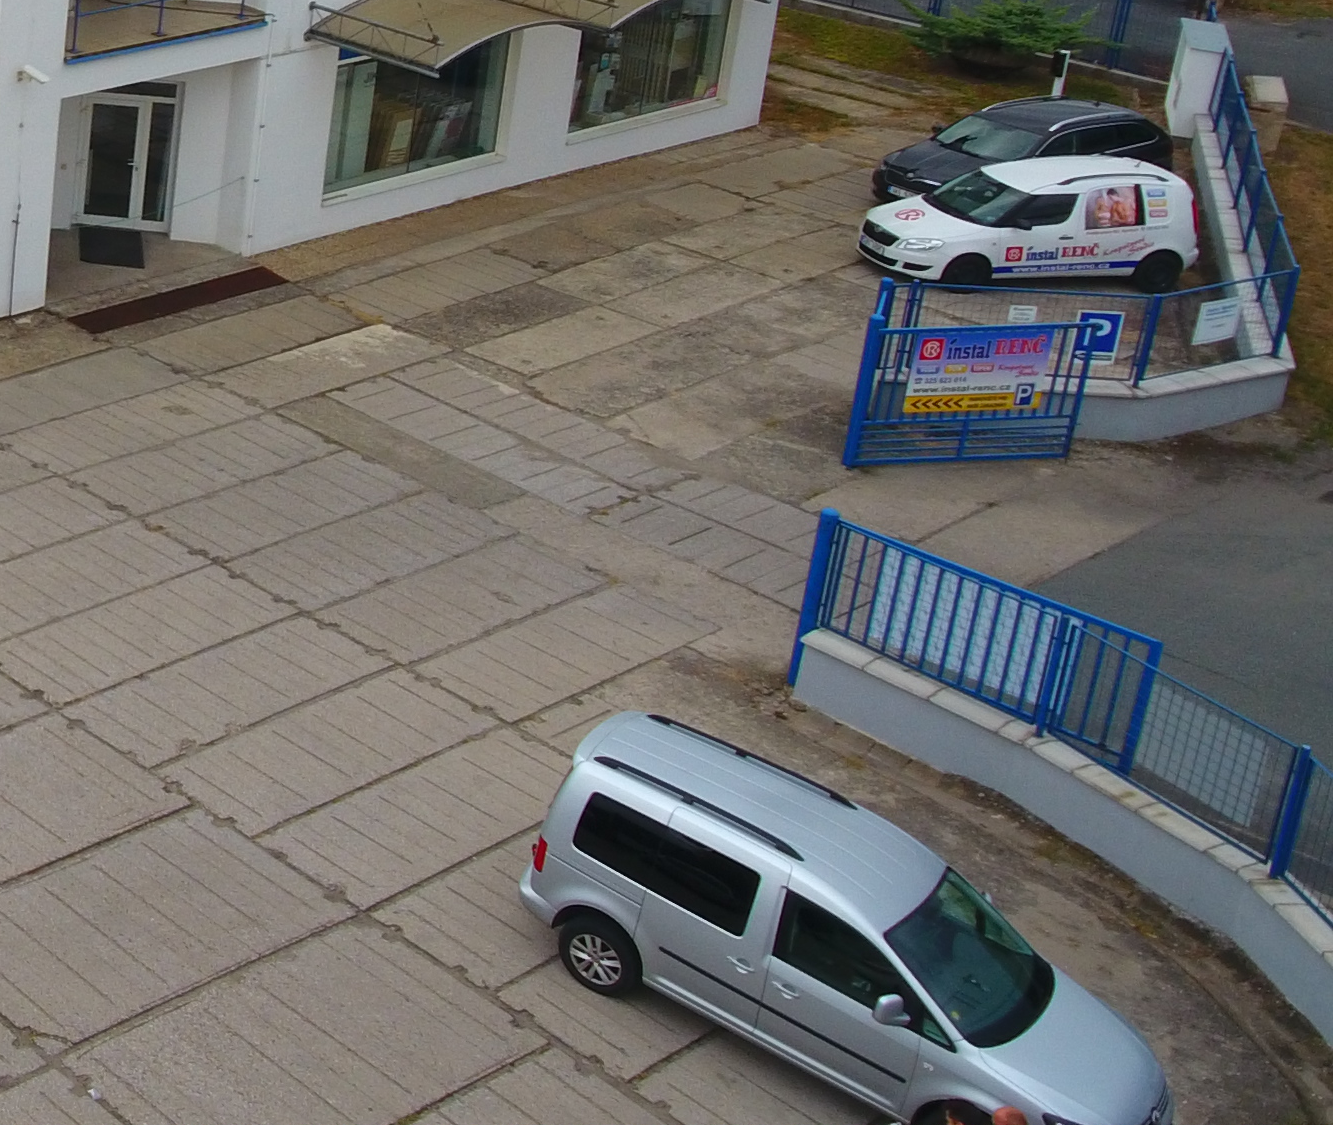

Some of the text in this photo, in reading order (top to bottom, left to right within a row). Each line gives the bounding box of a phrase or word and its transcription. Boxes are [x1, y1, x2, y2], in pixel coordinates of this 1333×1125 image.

[1025, 246, 1059, 262] instal
[947, 338, 991, 360] instal
[994, 334, 1047, 355] RENČ
[1016, 388, 1032, 403] P
